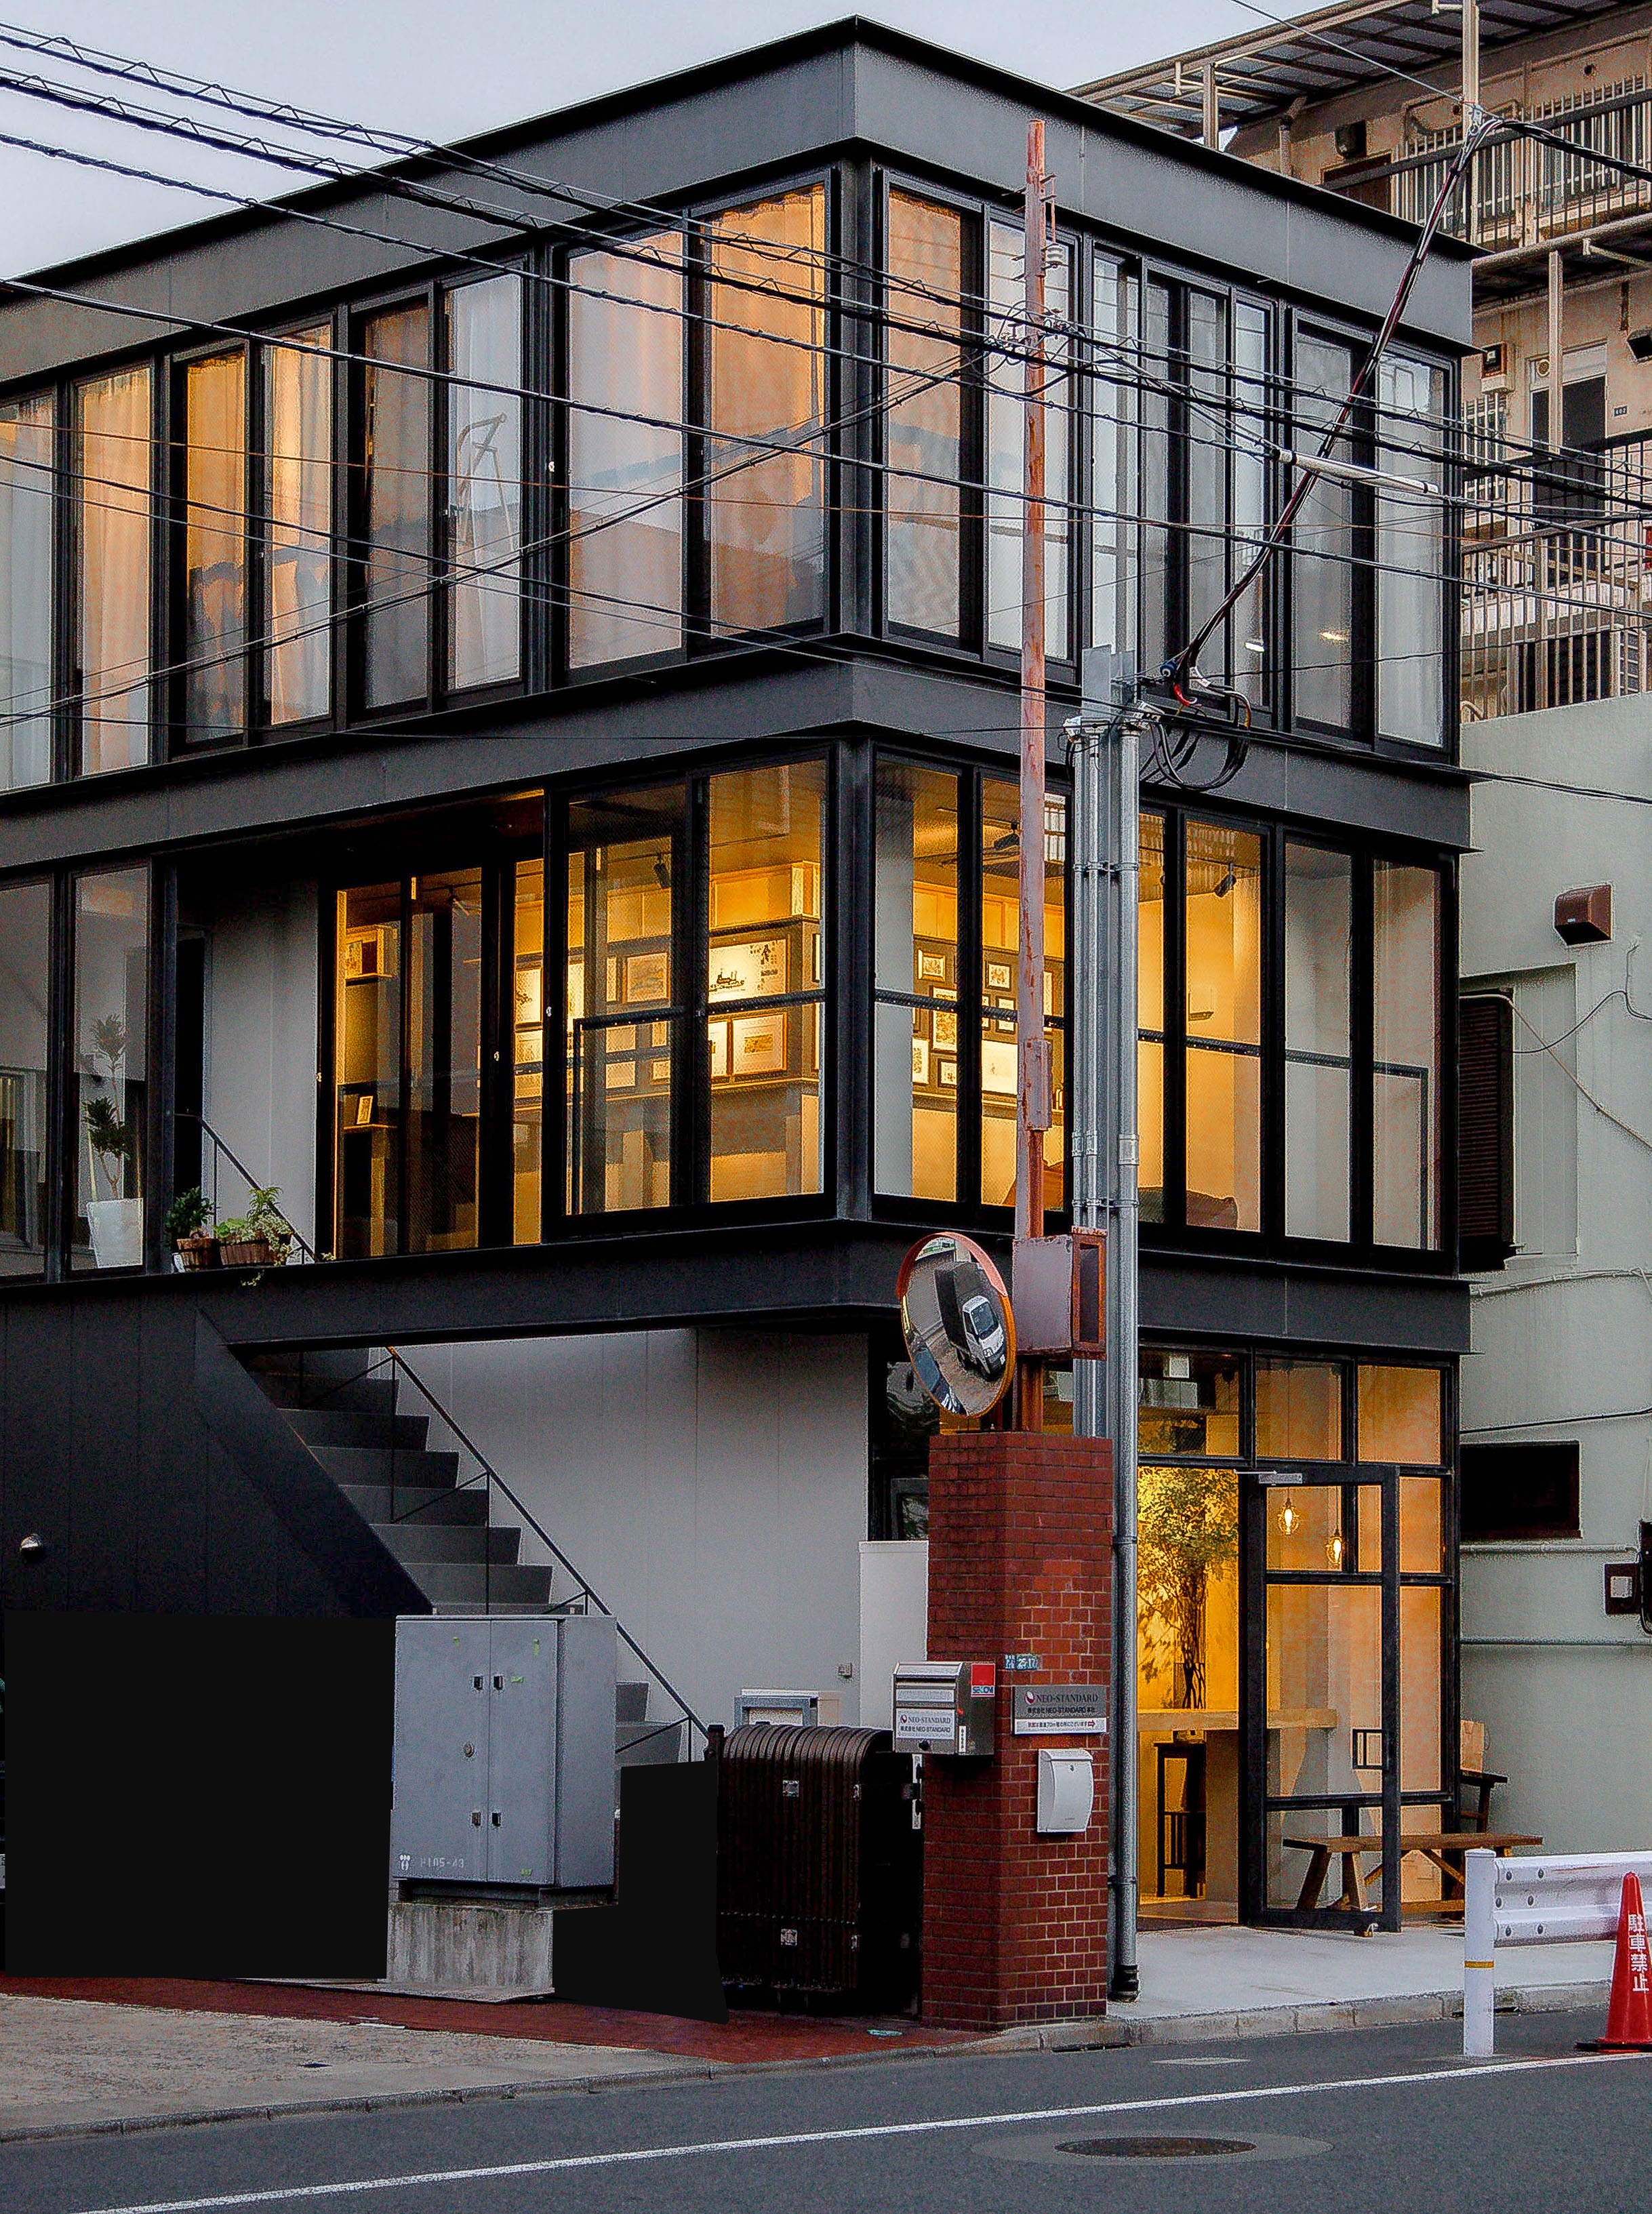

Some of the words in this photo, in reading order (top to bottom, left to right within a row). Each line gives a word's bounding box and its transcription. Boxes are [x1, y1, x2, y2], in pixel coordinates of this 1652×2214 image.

[972, 1686, 994, 1694] SECOM
[1036, 1693, 1098, 1703] NEO-STANDARD
[908, 1716, 951, 1724] NEO-STANDARD
[1628, 1914, 1650, 1992] 駐車禁止
